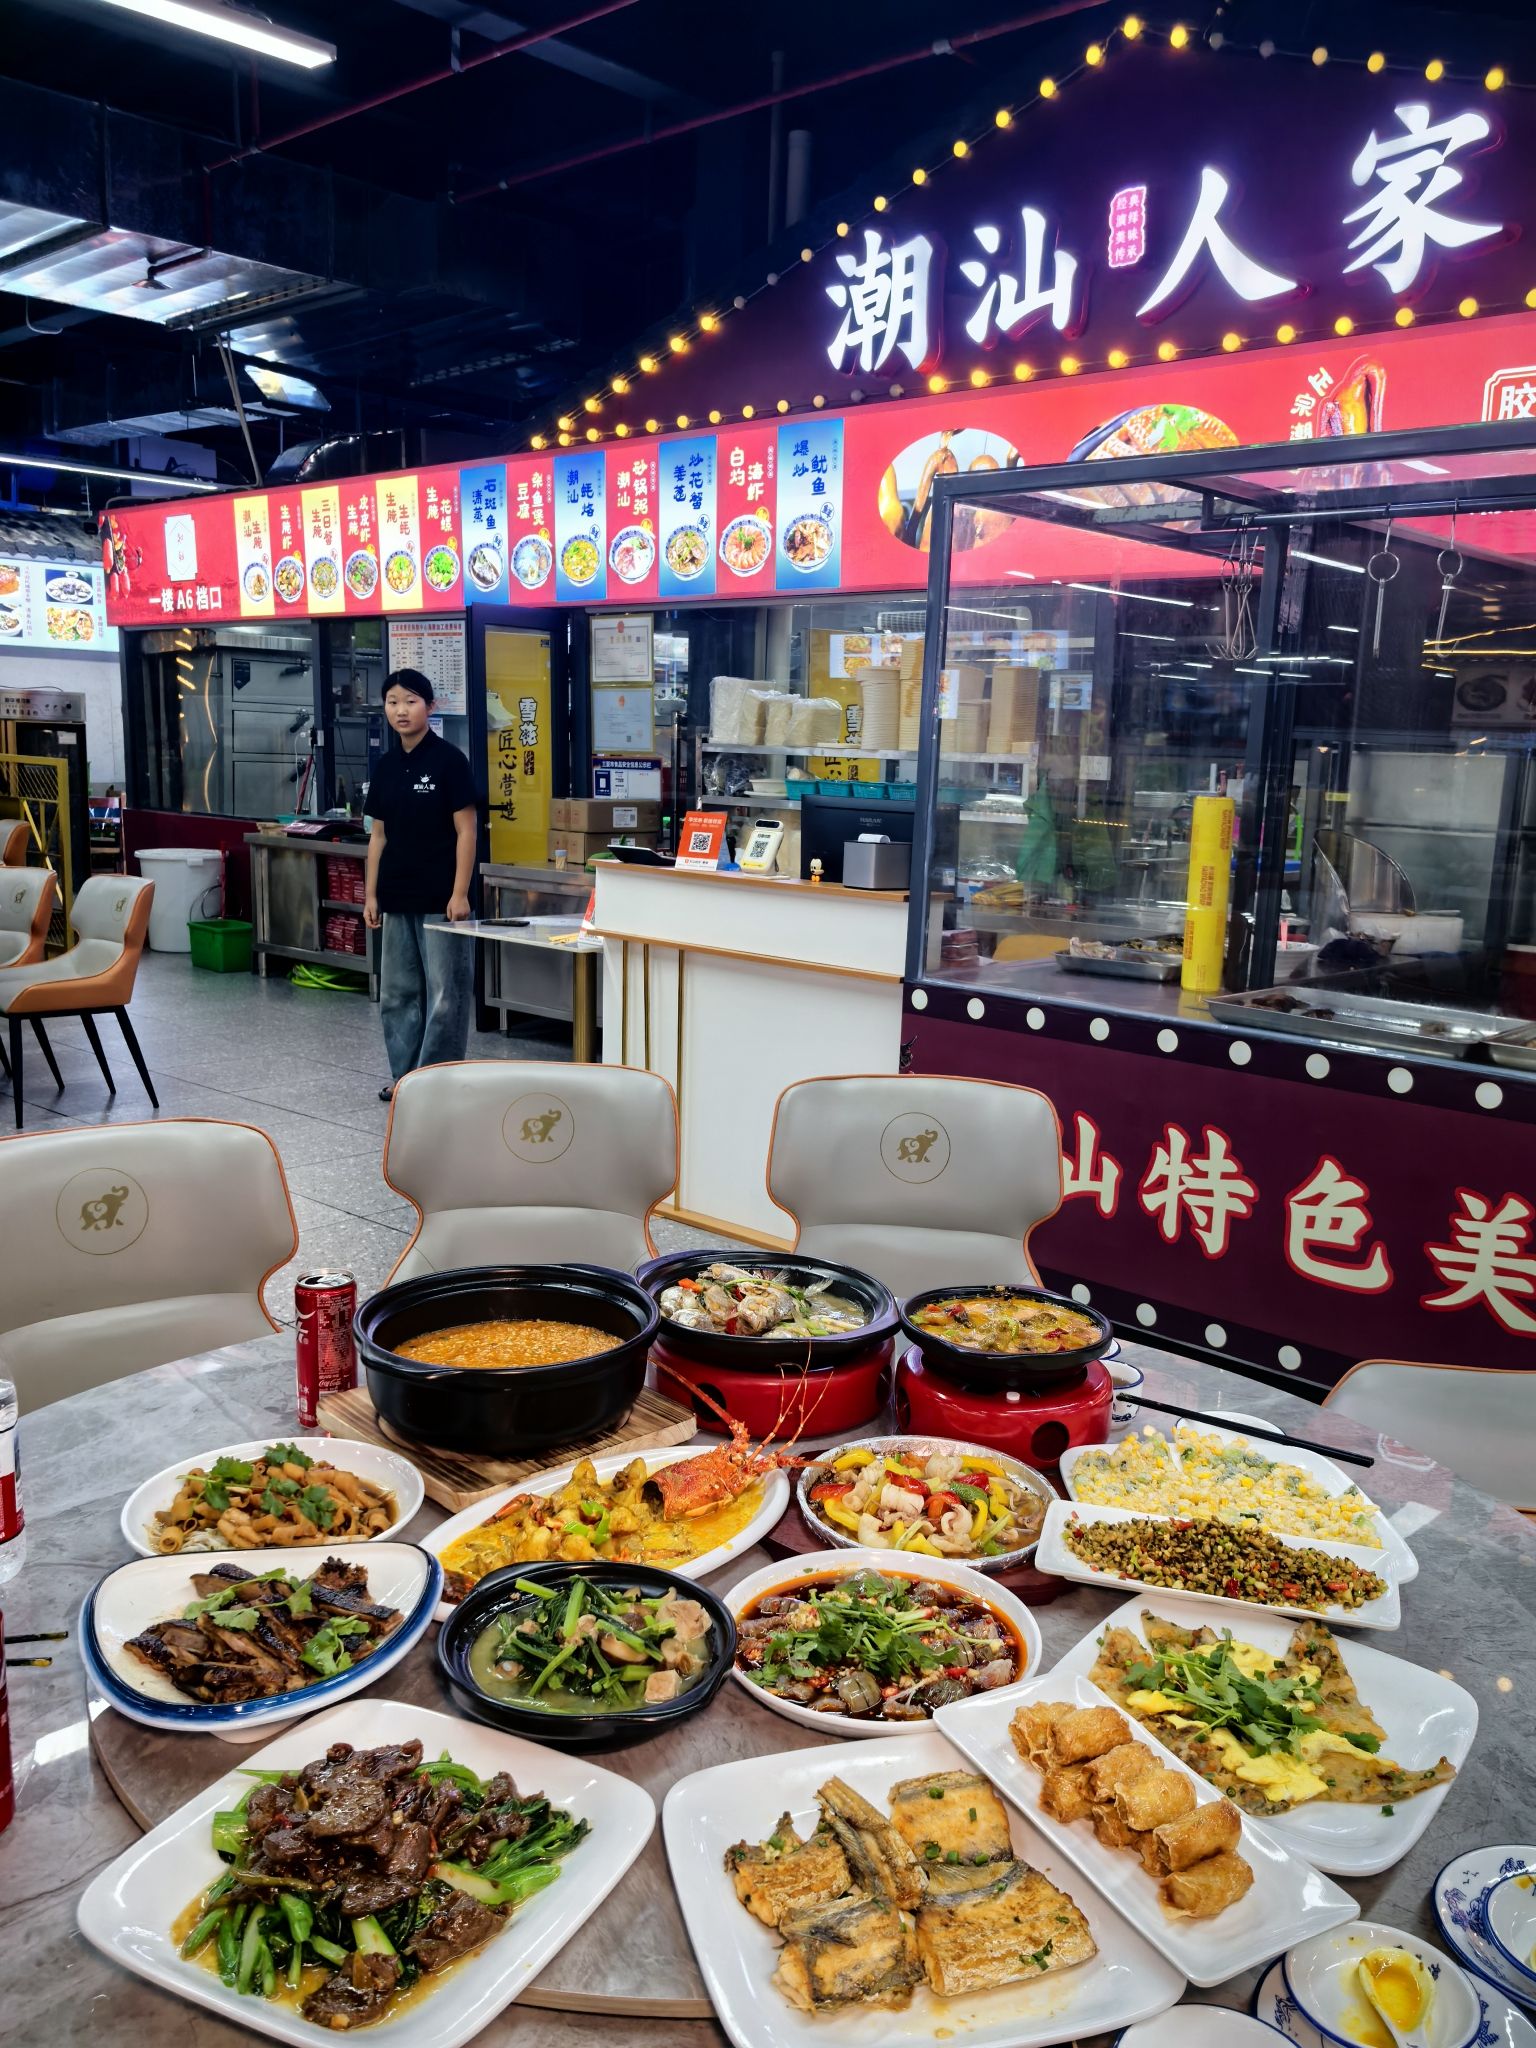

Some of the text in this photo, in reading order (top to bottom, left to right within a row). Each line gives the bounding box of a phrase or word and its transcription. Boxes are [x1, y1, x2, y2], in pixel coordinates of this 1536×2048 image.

[826, 105, 1503, 374] 潮汕人家
[729, 447, 745, 486] 白灼
[792, 440, 809, 477] 爆炒
[811, 455, 828, 496] 鱿鱼
[517, 482, 530, 519] 豆腐
[567, 469, 579, 504] 潮汕
[617, 471, 630, 507] 潮汕
[632, 459, 648, 515] 砂锅粥
[689, 453, 704, 510] 炒花蟹
[747, 462, 764, 501] 海虾
[484, 478, 496, 530] 石斑鱼
[149, 587, 222, 612] 一楼 A6 档口
[498, 729, 518, 821] 匠心营造
